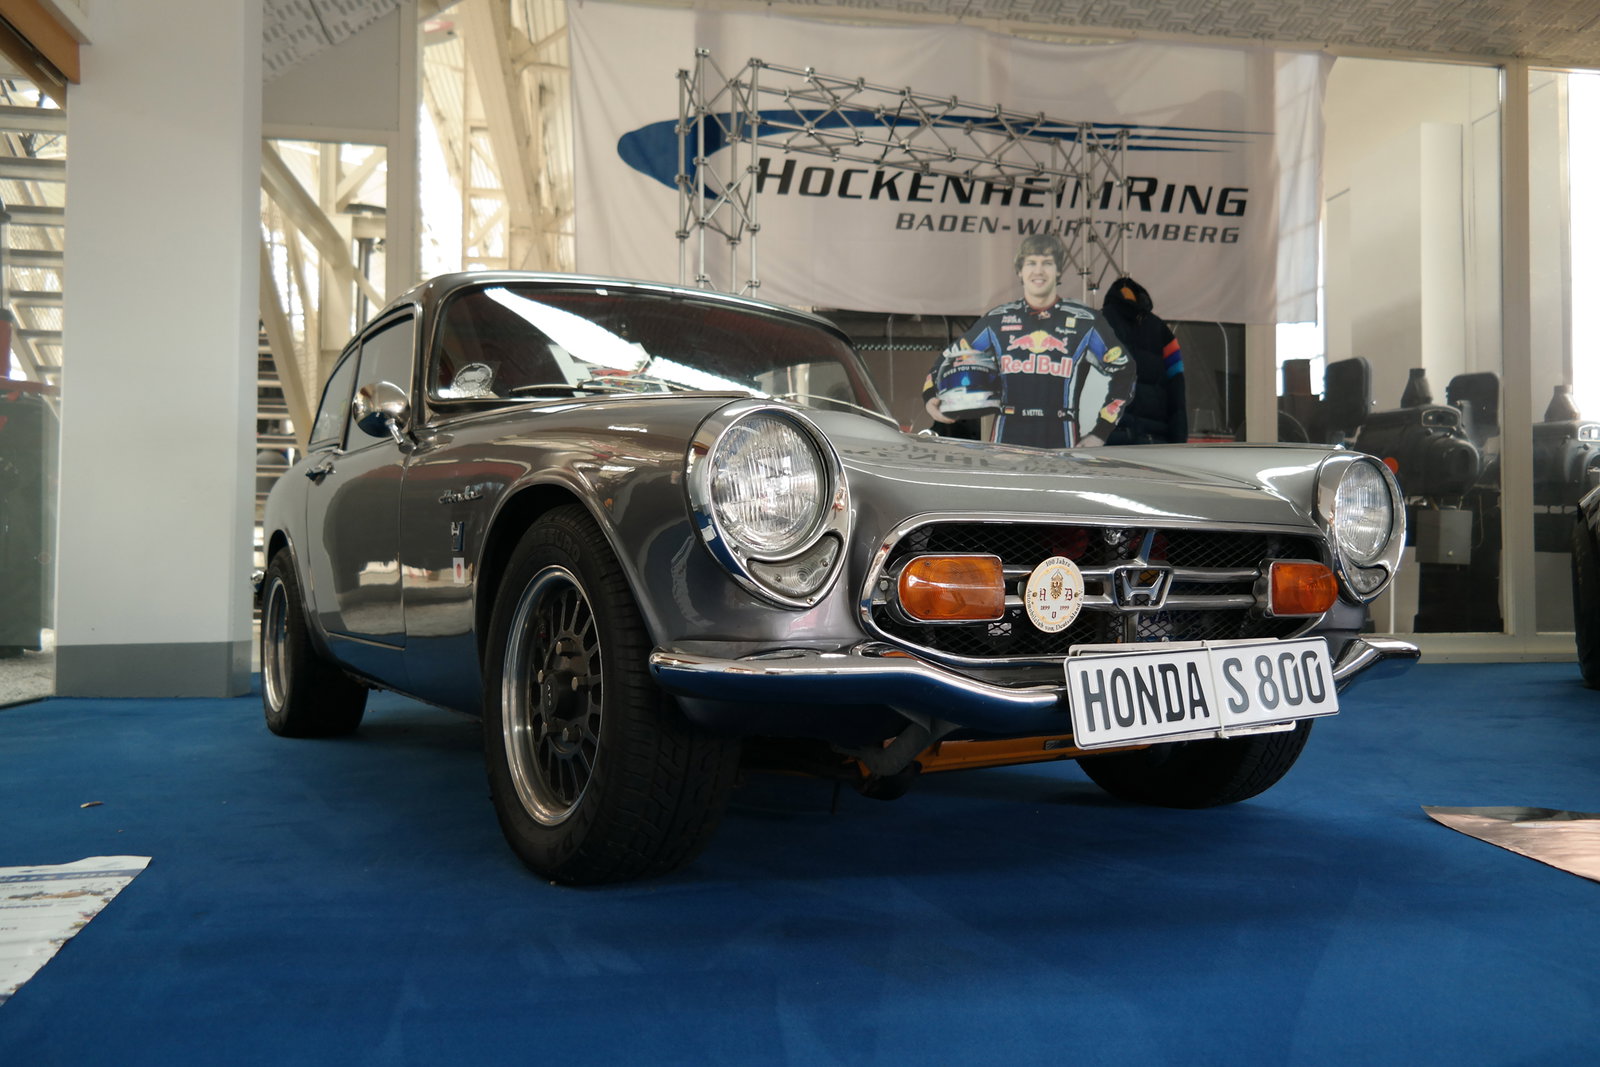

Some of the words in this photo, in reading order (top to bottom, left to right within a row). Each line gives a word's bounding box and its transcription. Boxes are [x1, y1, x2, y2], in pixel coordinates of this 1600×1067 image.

[1000, 354, 1036, 374] Red
[1036, 354, 1073, 378] Bull
[1080, 662, 1210, 732] HONDA
[1222, 657, 1250, 714] S
[1254, 650, 1327, 711] 800
